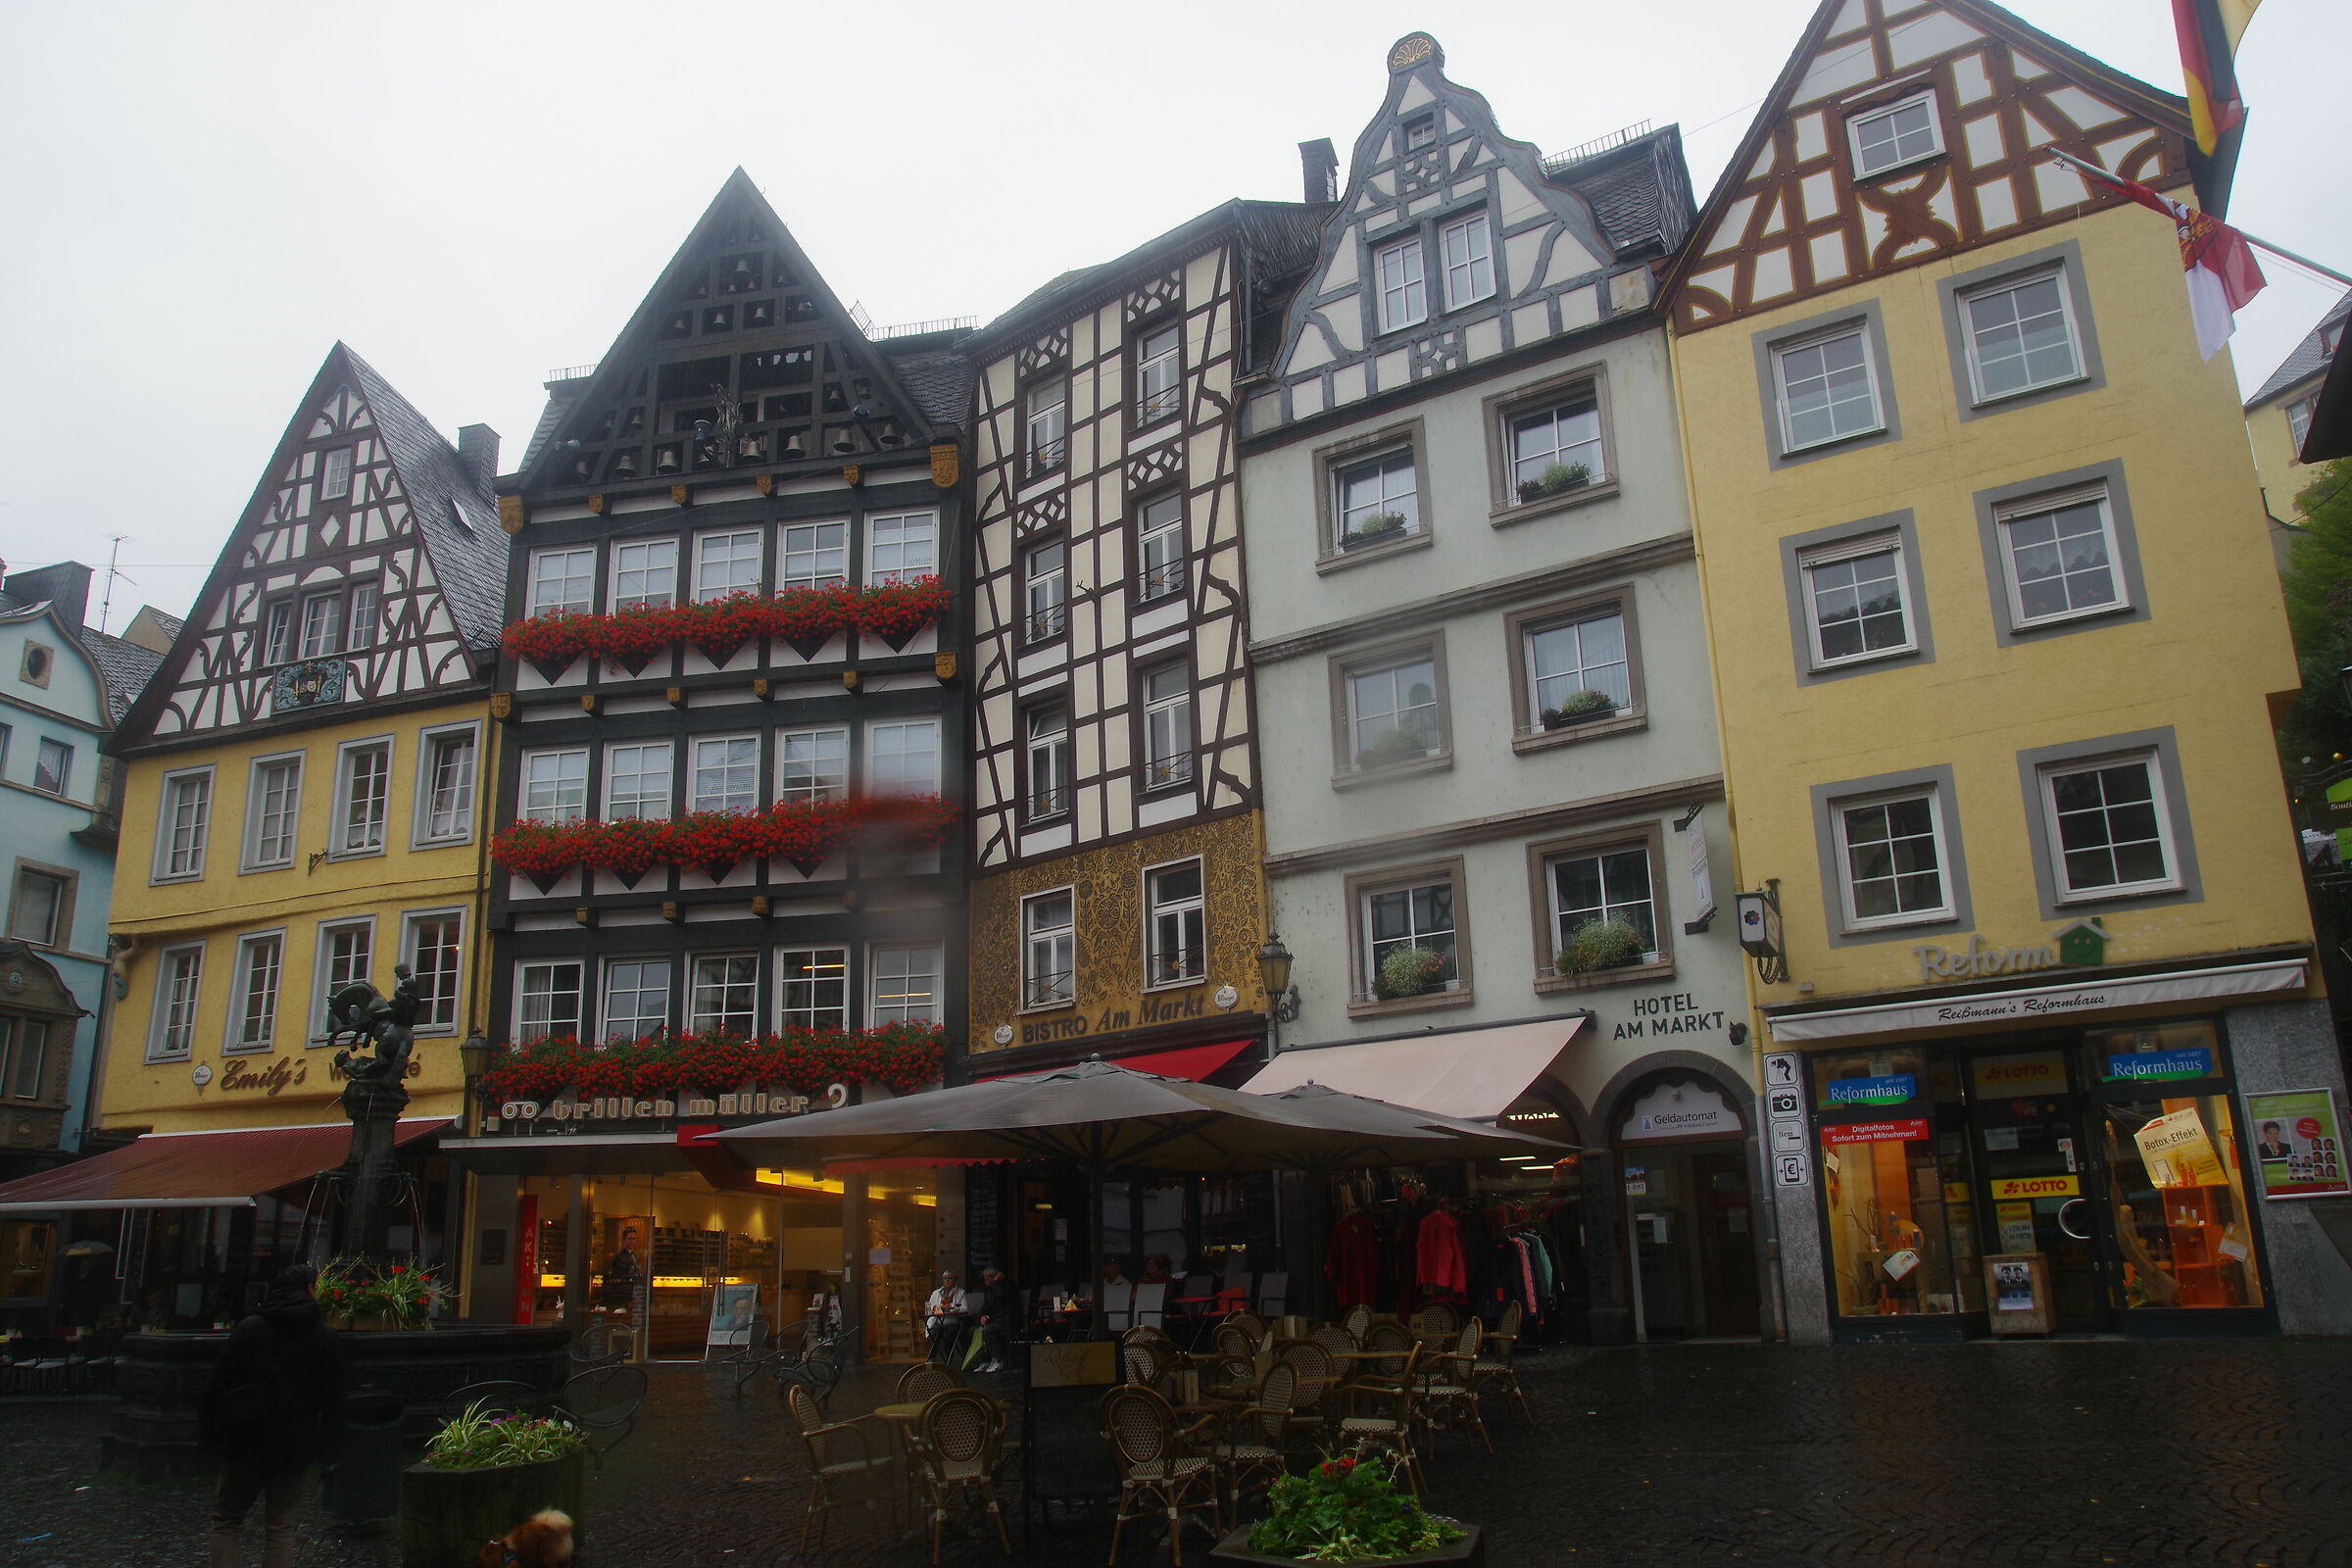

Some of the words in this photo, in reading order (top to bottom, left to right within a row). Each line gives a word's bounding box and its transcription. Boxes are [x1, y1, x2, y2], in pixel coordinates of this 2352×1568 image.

[1913, 934, 2058, 980] Reform
[1634, 993, 1698, 1016] HOTEL
[1937, 1001, 2017, 1020] Reißmann's
[2023, 995, 2106, 1012] Reformhaus
[1022, 1015, 1088, 1043] BISTRO
[1095, 1006, 1130, 1031] Am
[1137, 993, 1204, 1024] Markt
[1613, 1020, 1648, 1040] AM
[1652, 1011, 1724, 1036] MARKT
[2005, 1064, 2048, 1078] LOTTO
[2113, 1058, 2203, 1080] Reformhaus
[1831, 1084, 1908, 1103] Reformhaus
[553, 1097, 675, 1120] brillen
[689, 1092, 809, 1116] müller
[1654, 1111, 1718, 1125] Geldautomat
[1852, 1124, 1894, 1133] Digitalfotos
[1873, 1131, 1917, 1140] Mitnehmen!
[2144, 1127, 2199, 1152] Botox-Effekt
[2022, 1180, 2068, 1193] LOTTO
